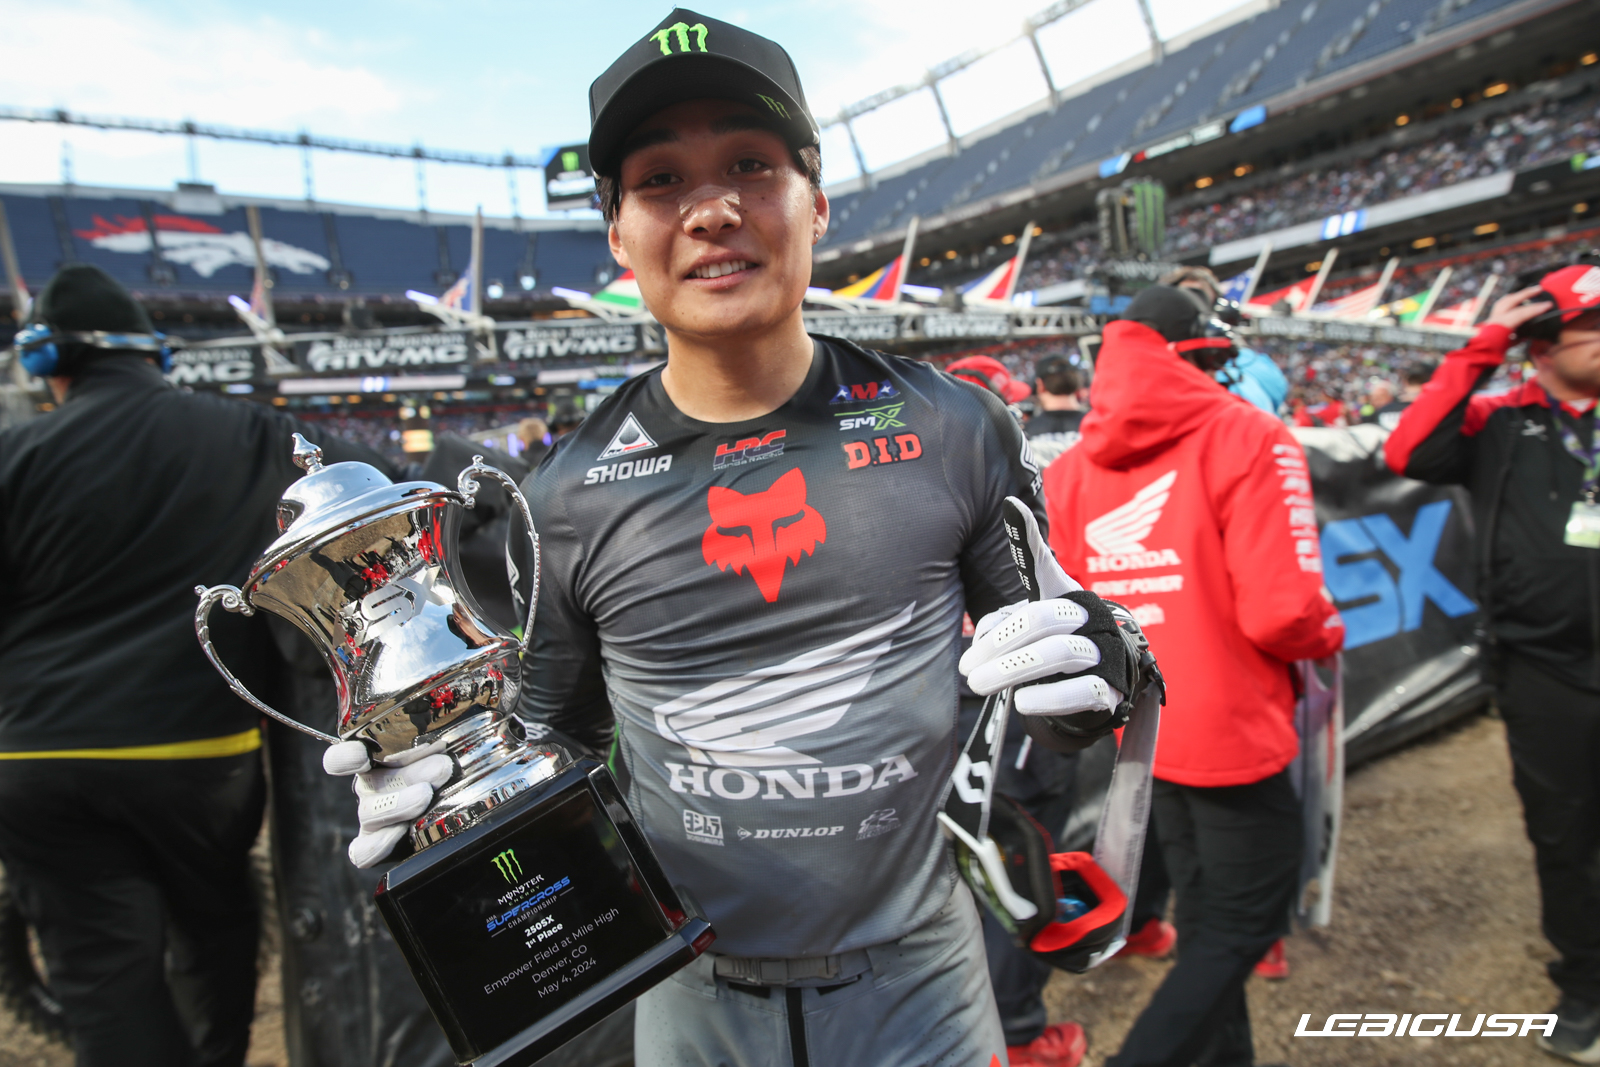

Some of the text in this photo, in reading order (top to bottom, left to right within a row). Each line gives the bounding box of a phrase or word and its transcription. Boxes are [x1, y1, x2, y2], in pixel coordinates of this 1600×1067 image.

[830, 379, 899, 401] AMA
[839, 406, 907, 431] SMX
[713, 429, 787, 468] HRC
[843, 432, 923, 470] D.I.D
[583, 454, 674, 485] SHOWA
[1085, 548, 1182, 573] HONDA
[665, 754, 919, 800] HONDA
[753, 825, 845, 840] DUNLOP
[487, 875, 571, 932] SUPERCROSS
[498, 874, 545, 905] MONSTER
[507, 895, 558, 929] CHAMPIONSHIP
[524, 914, 555, 937] 250SX
[483, 906, 620, 995] Empower Field at Mile High
[525, 922, 564, 949] 1st Place
[531, 944, 588, 984] Denver, CO
[537, 956, 597, 999] May 4, 2024
